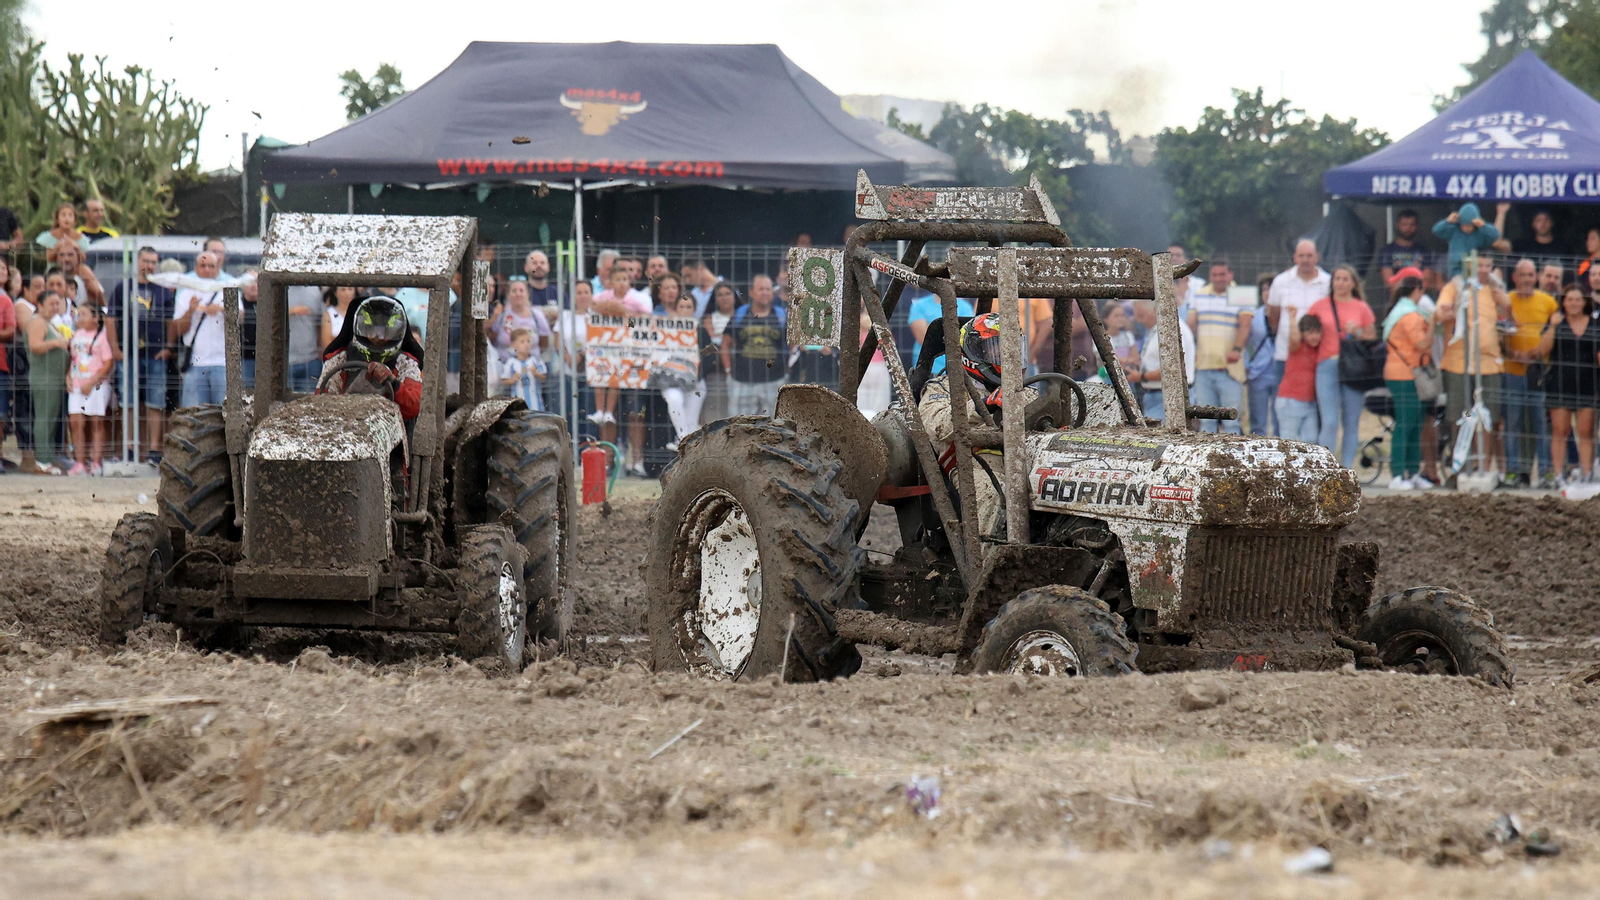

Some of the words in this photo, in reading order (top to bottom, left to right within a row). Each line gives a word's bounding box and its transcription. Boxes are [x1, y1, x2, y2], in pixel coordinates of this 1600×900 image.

[567, 88, 642, 102] mas4x4
[1448, 111, 1574, 131] NERJA
[437, 157, 724, 177] www.mas4x4.com
[1372, 175, 1436, 197] NERJA
[1446, 174, 1487, 198] 4X4
[1496, 173, 1569, 198] HOBBY
[1041, 479, 1149, 505] ADRIAN
